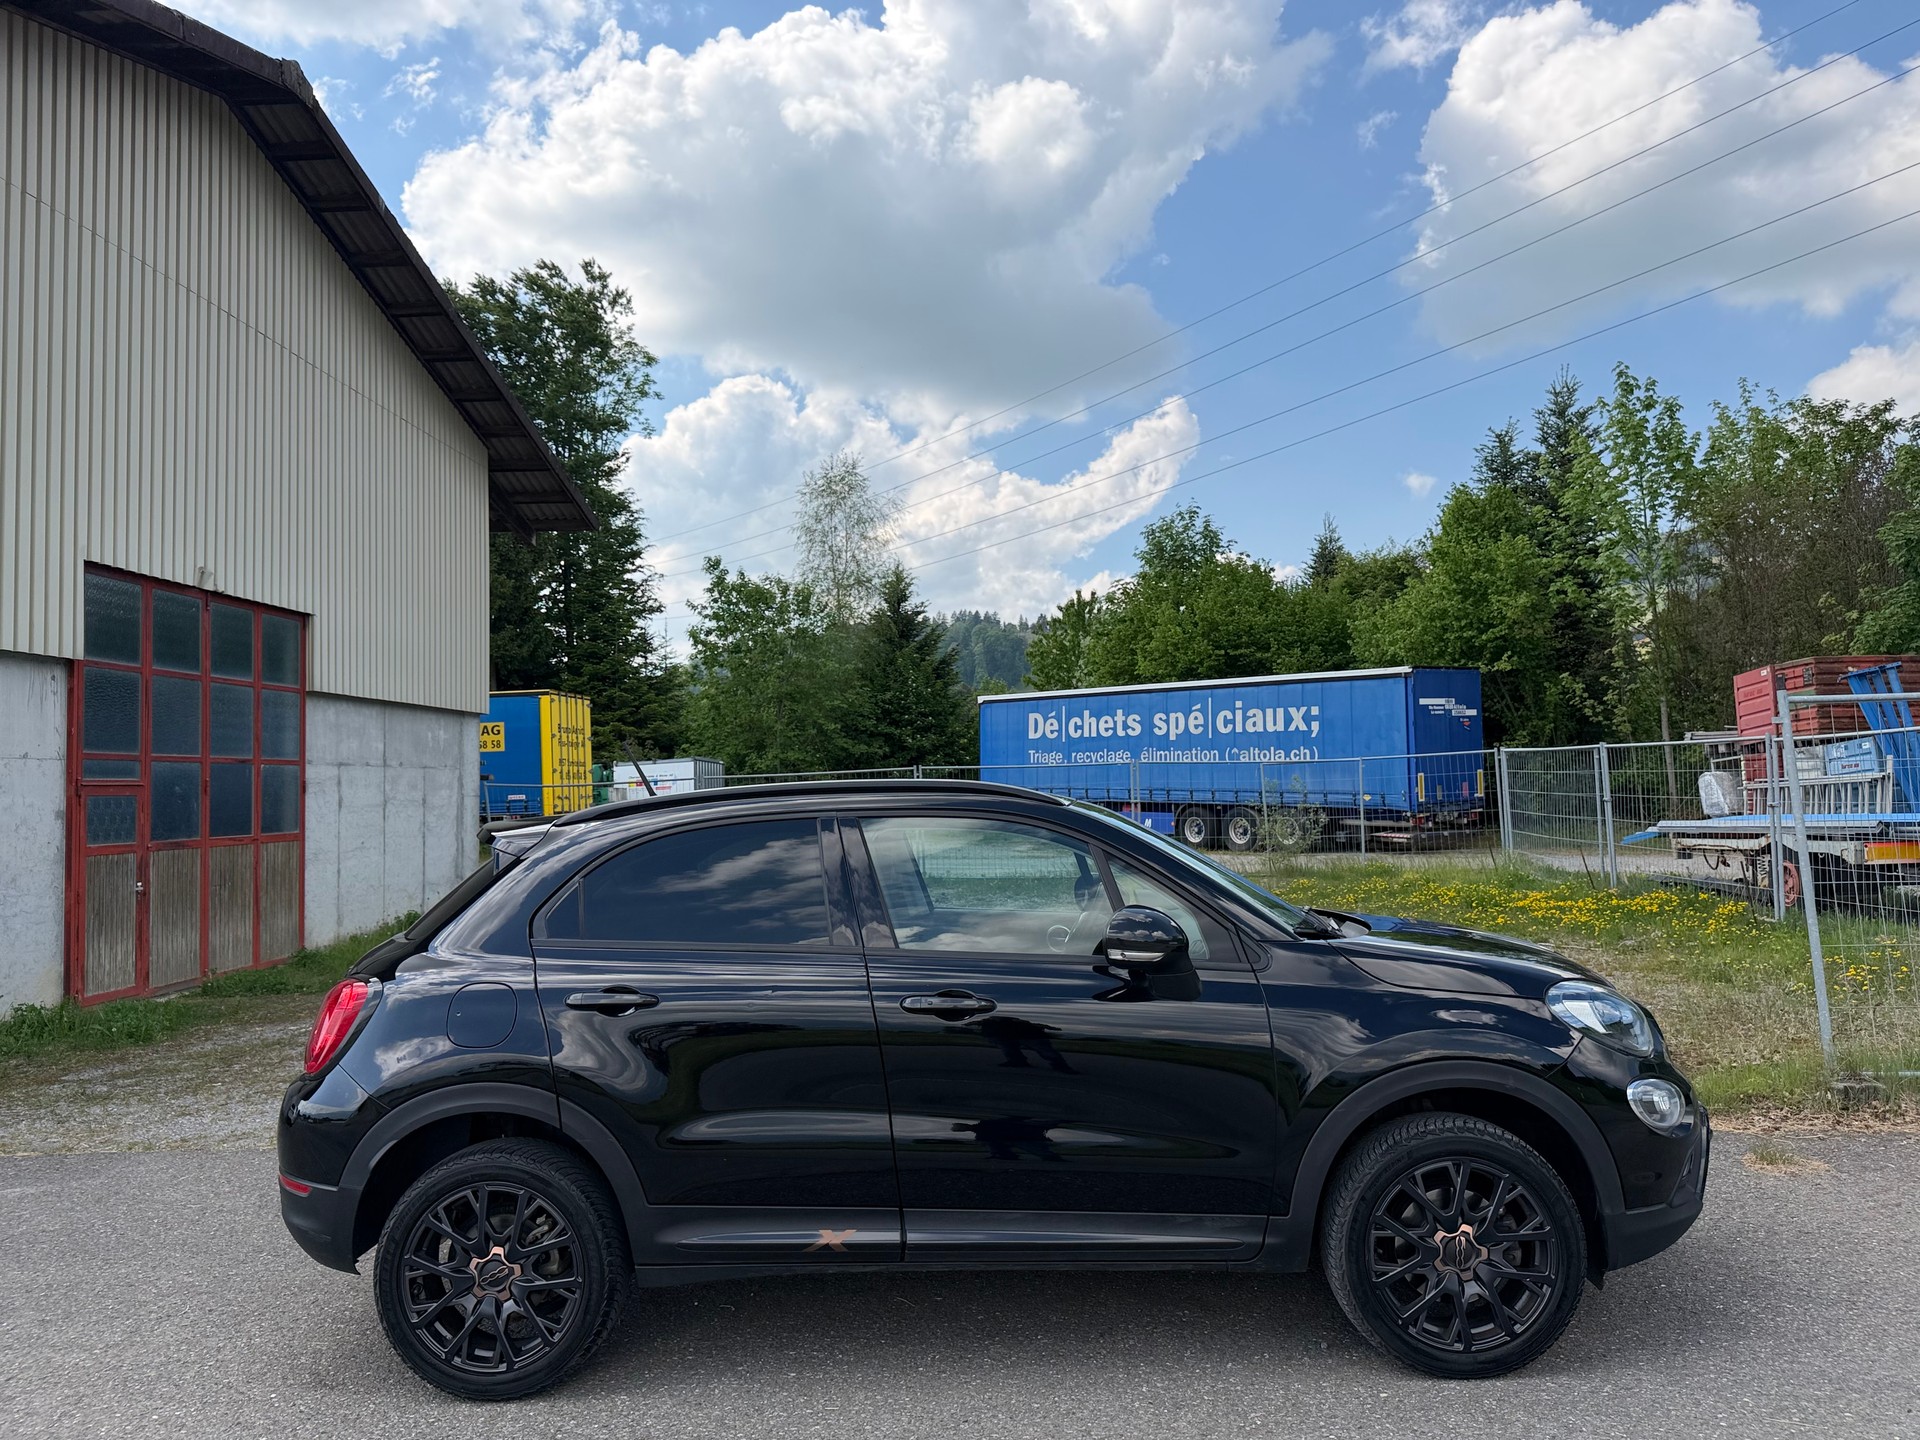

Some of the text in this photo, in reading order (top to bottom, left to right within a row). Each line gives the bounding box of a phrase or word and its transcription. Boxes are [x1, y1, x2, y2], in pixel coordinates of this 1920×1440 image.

[480, 724, 501, 736] AG
[491, 739, 502, 749] 58
[1028, 749, 1068, 765] Triage,
[1071, 748, 1135, 765] recyclage,
[1140, 746, 1219, 763] élimination
